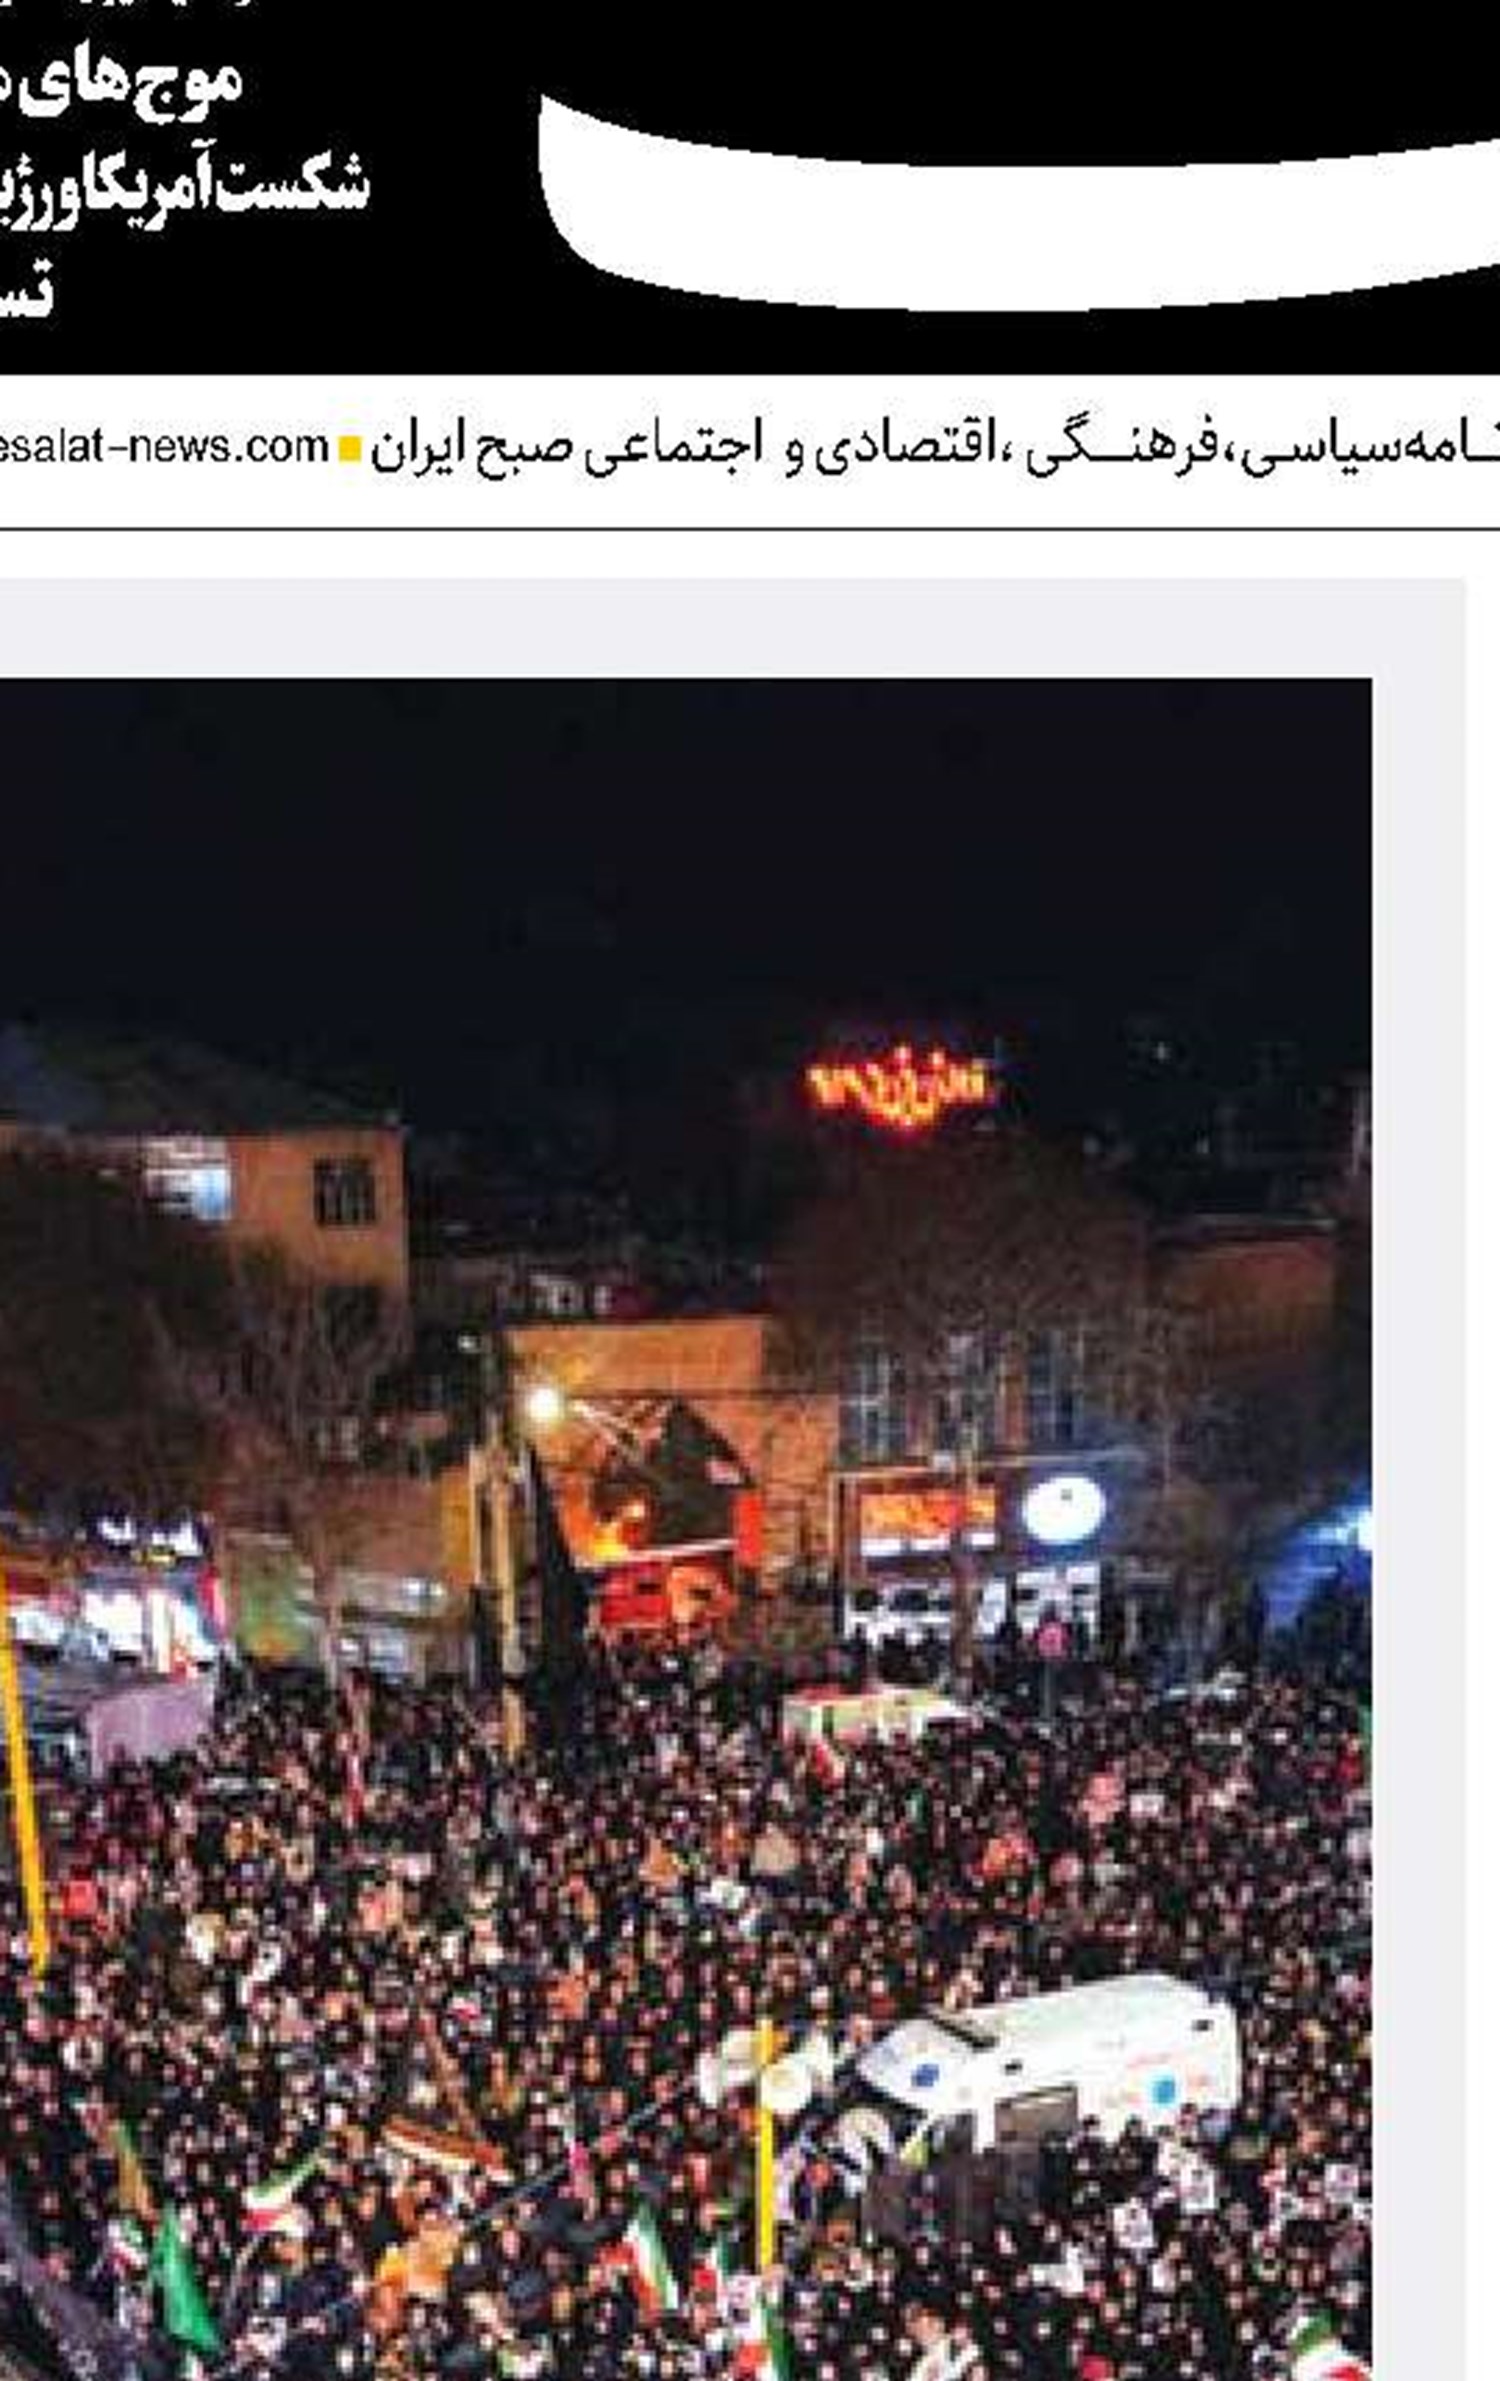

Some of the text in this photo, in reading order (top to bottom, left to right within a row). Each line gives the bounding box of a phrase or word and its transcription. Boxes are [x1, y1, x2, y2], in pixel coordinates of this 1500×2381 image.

[372, 416, 464, 477] ایران
[477, 436, 572, 481] صبح
[586, 417, 761, 478] اجتماعی
[785, 439, 803, 478] و
